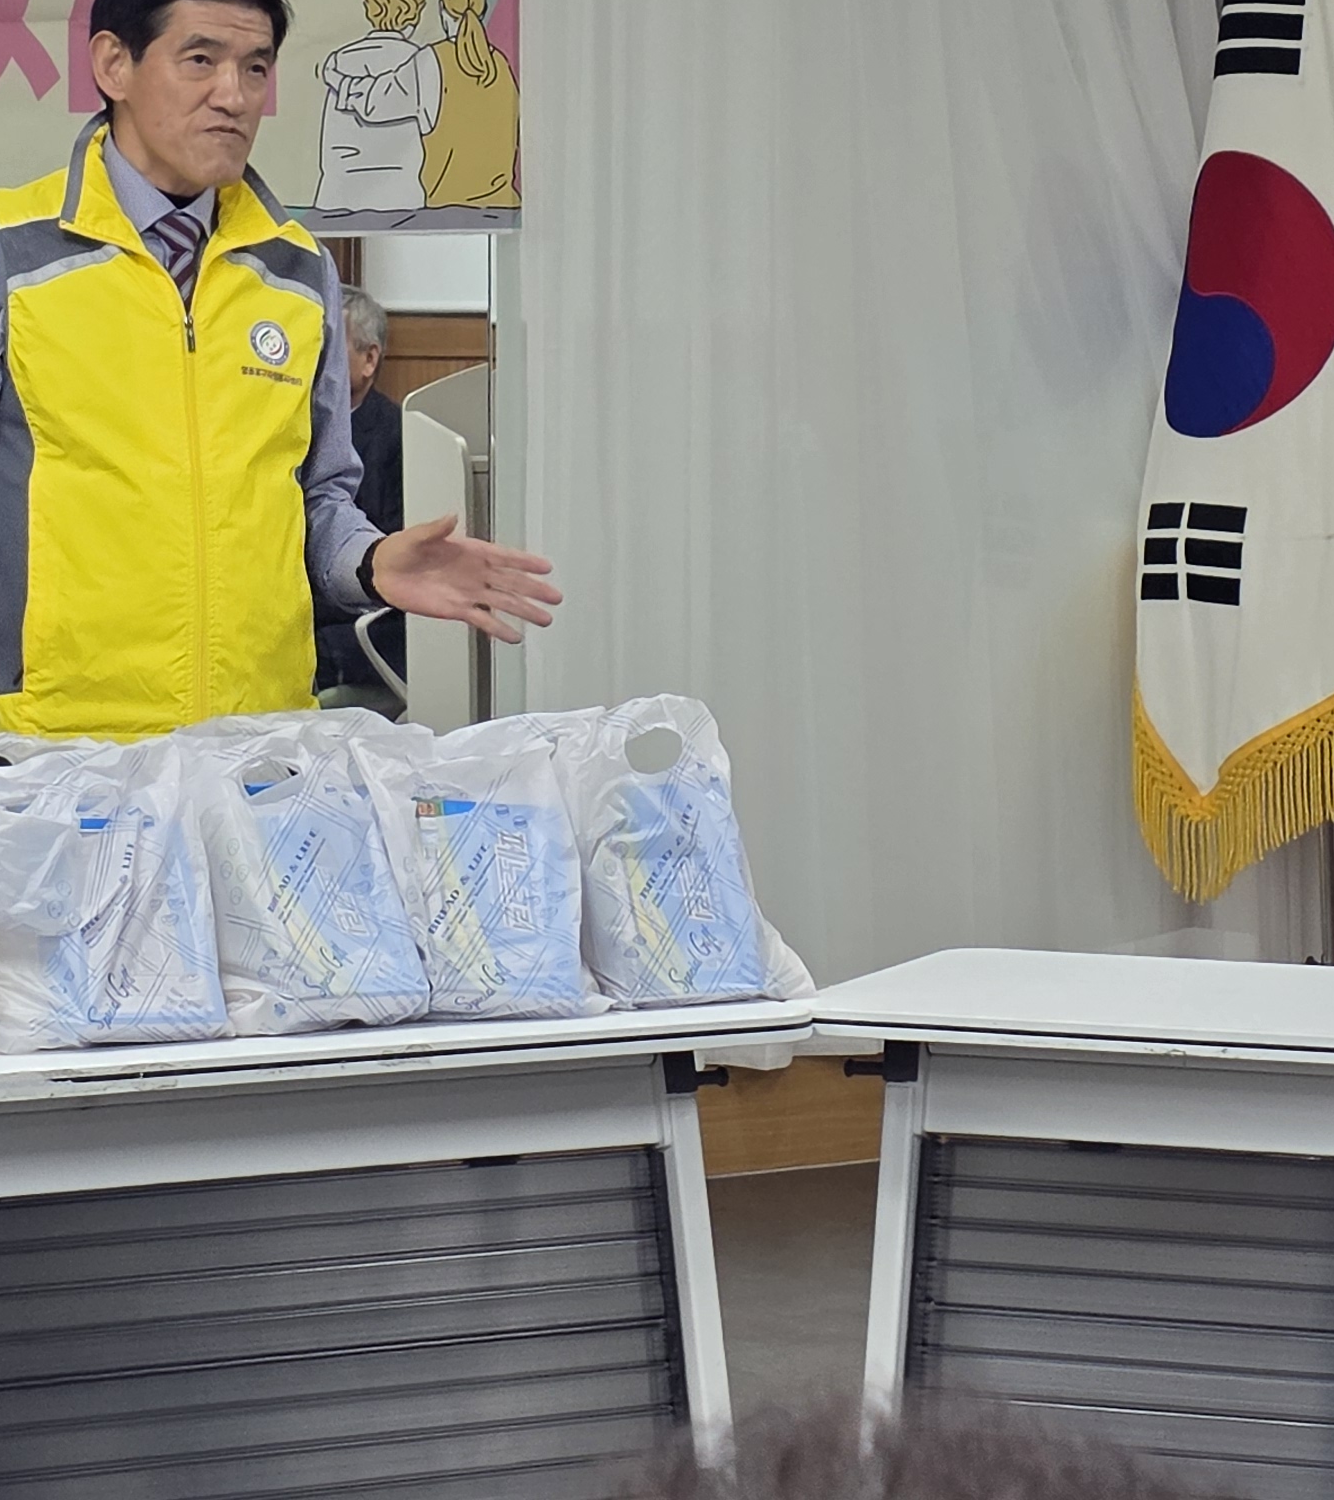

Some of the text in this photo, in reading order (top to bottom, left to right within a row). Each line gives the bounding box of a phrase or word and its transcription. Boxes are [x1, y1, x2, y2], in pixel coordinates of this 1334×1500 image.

[640, 849, 674, 901] BREAD
[427, 888, 461, 936] BREAD
[454, 976, 498, 1011] Special
[668, 946, 704, 994] Special
[87, 986, 122, 1031] Special
[107, 963, 141, 999] Gift
